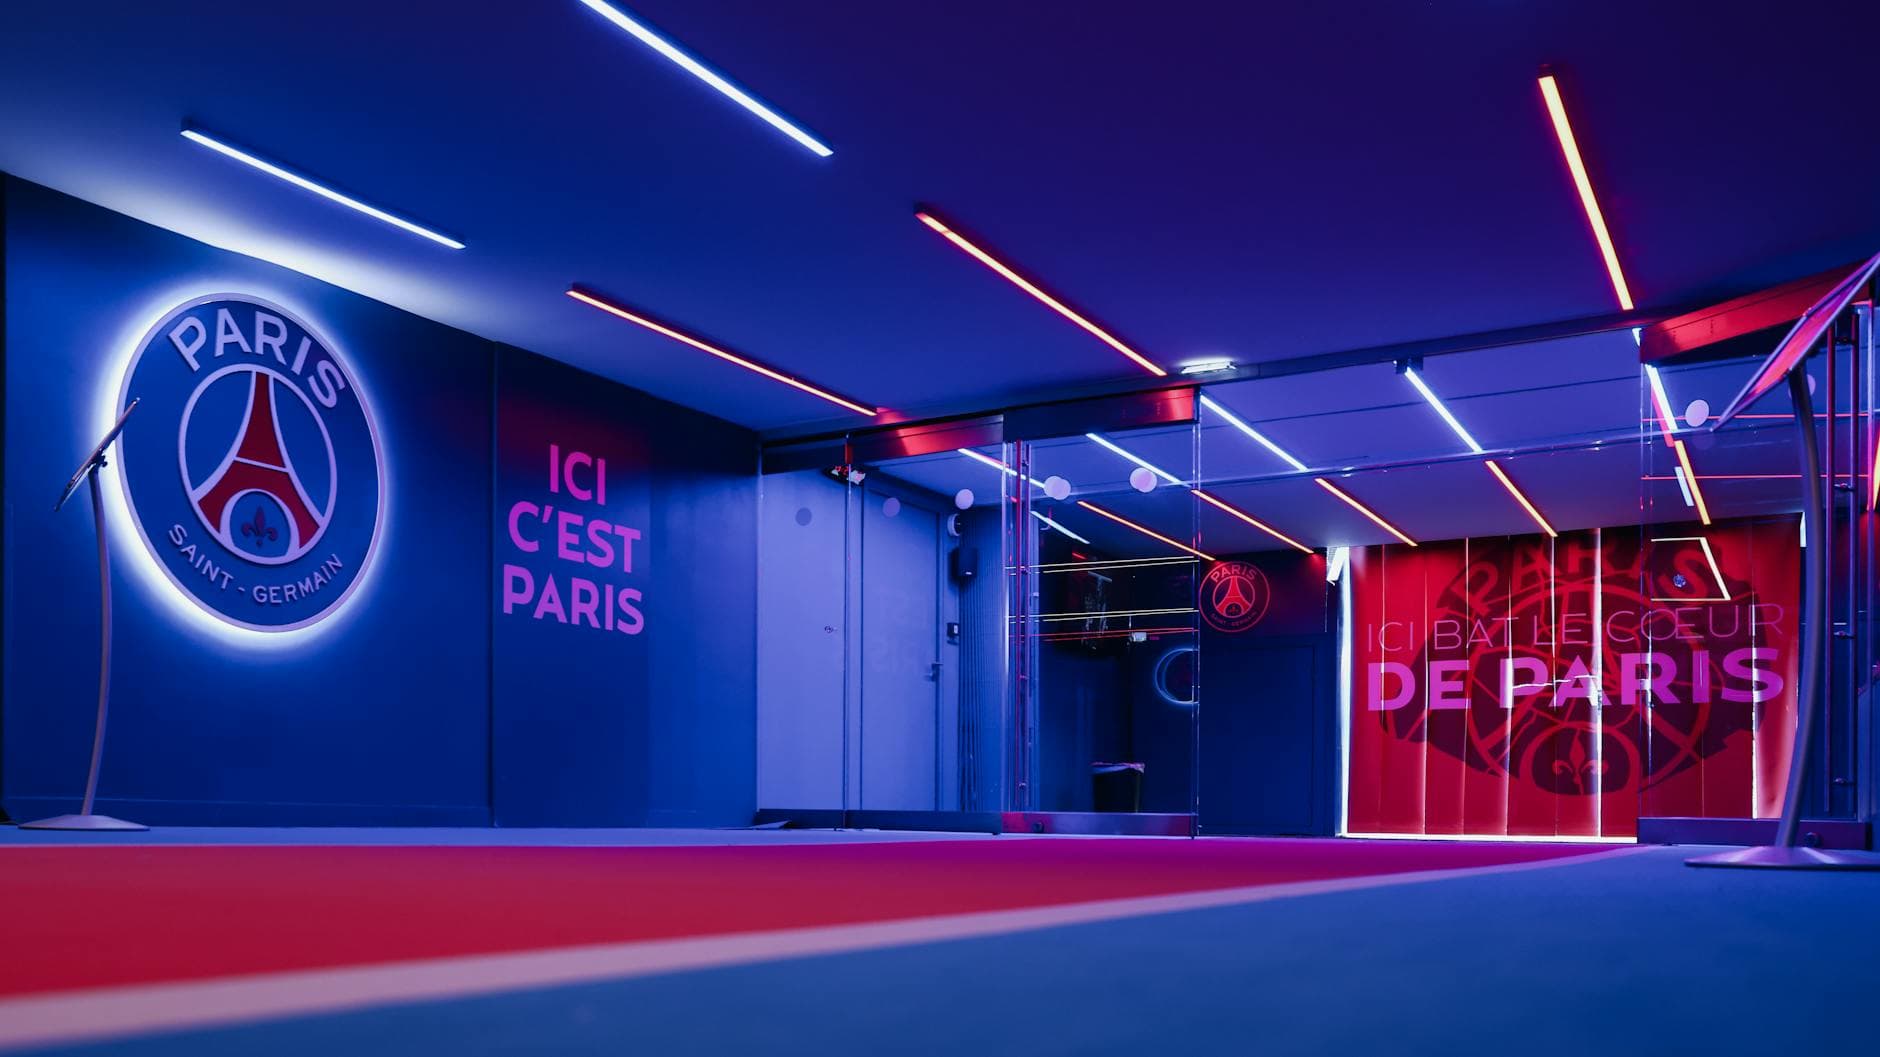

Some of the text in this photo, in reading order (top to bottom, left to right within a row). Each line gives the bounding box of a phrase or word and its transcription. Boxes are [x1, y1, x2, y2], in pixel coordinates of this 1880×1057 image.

[168, 307, 346, 408] PARIS
[550, 444, 606, 506] ICI
[169, 524, 234, 590] SAINT
[252, 553, 343, 604] GERMAIN
[508, 501, 641, 573] C'EST
[503, 564, 645, 635] PARIS
[1210, 564, 1257, 583] PARIS
[1367, 603, 1785, 653] ICI BAT LE CŒUR
[1367, 647, 1785, 712] DE PARIS
